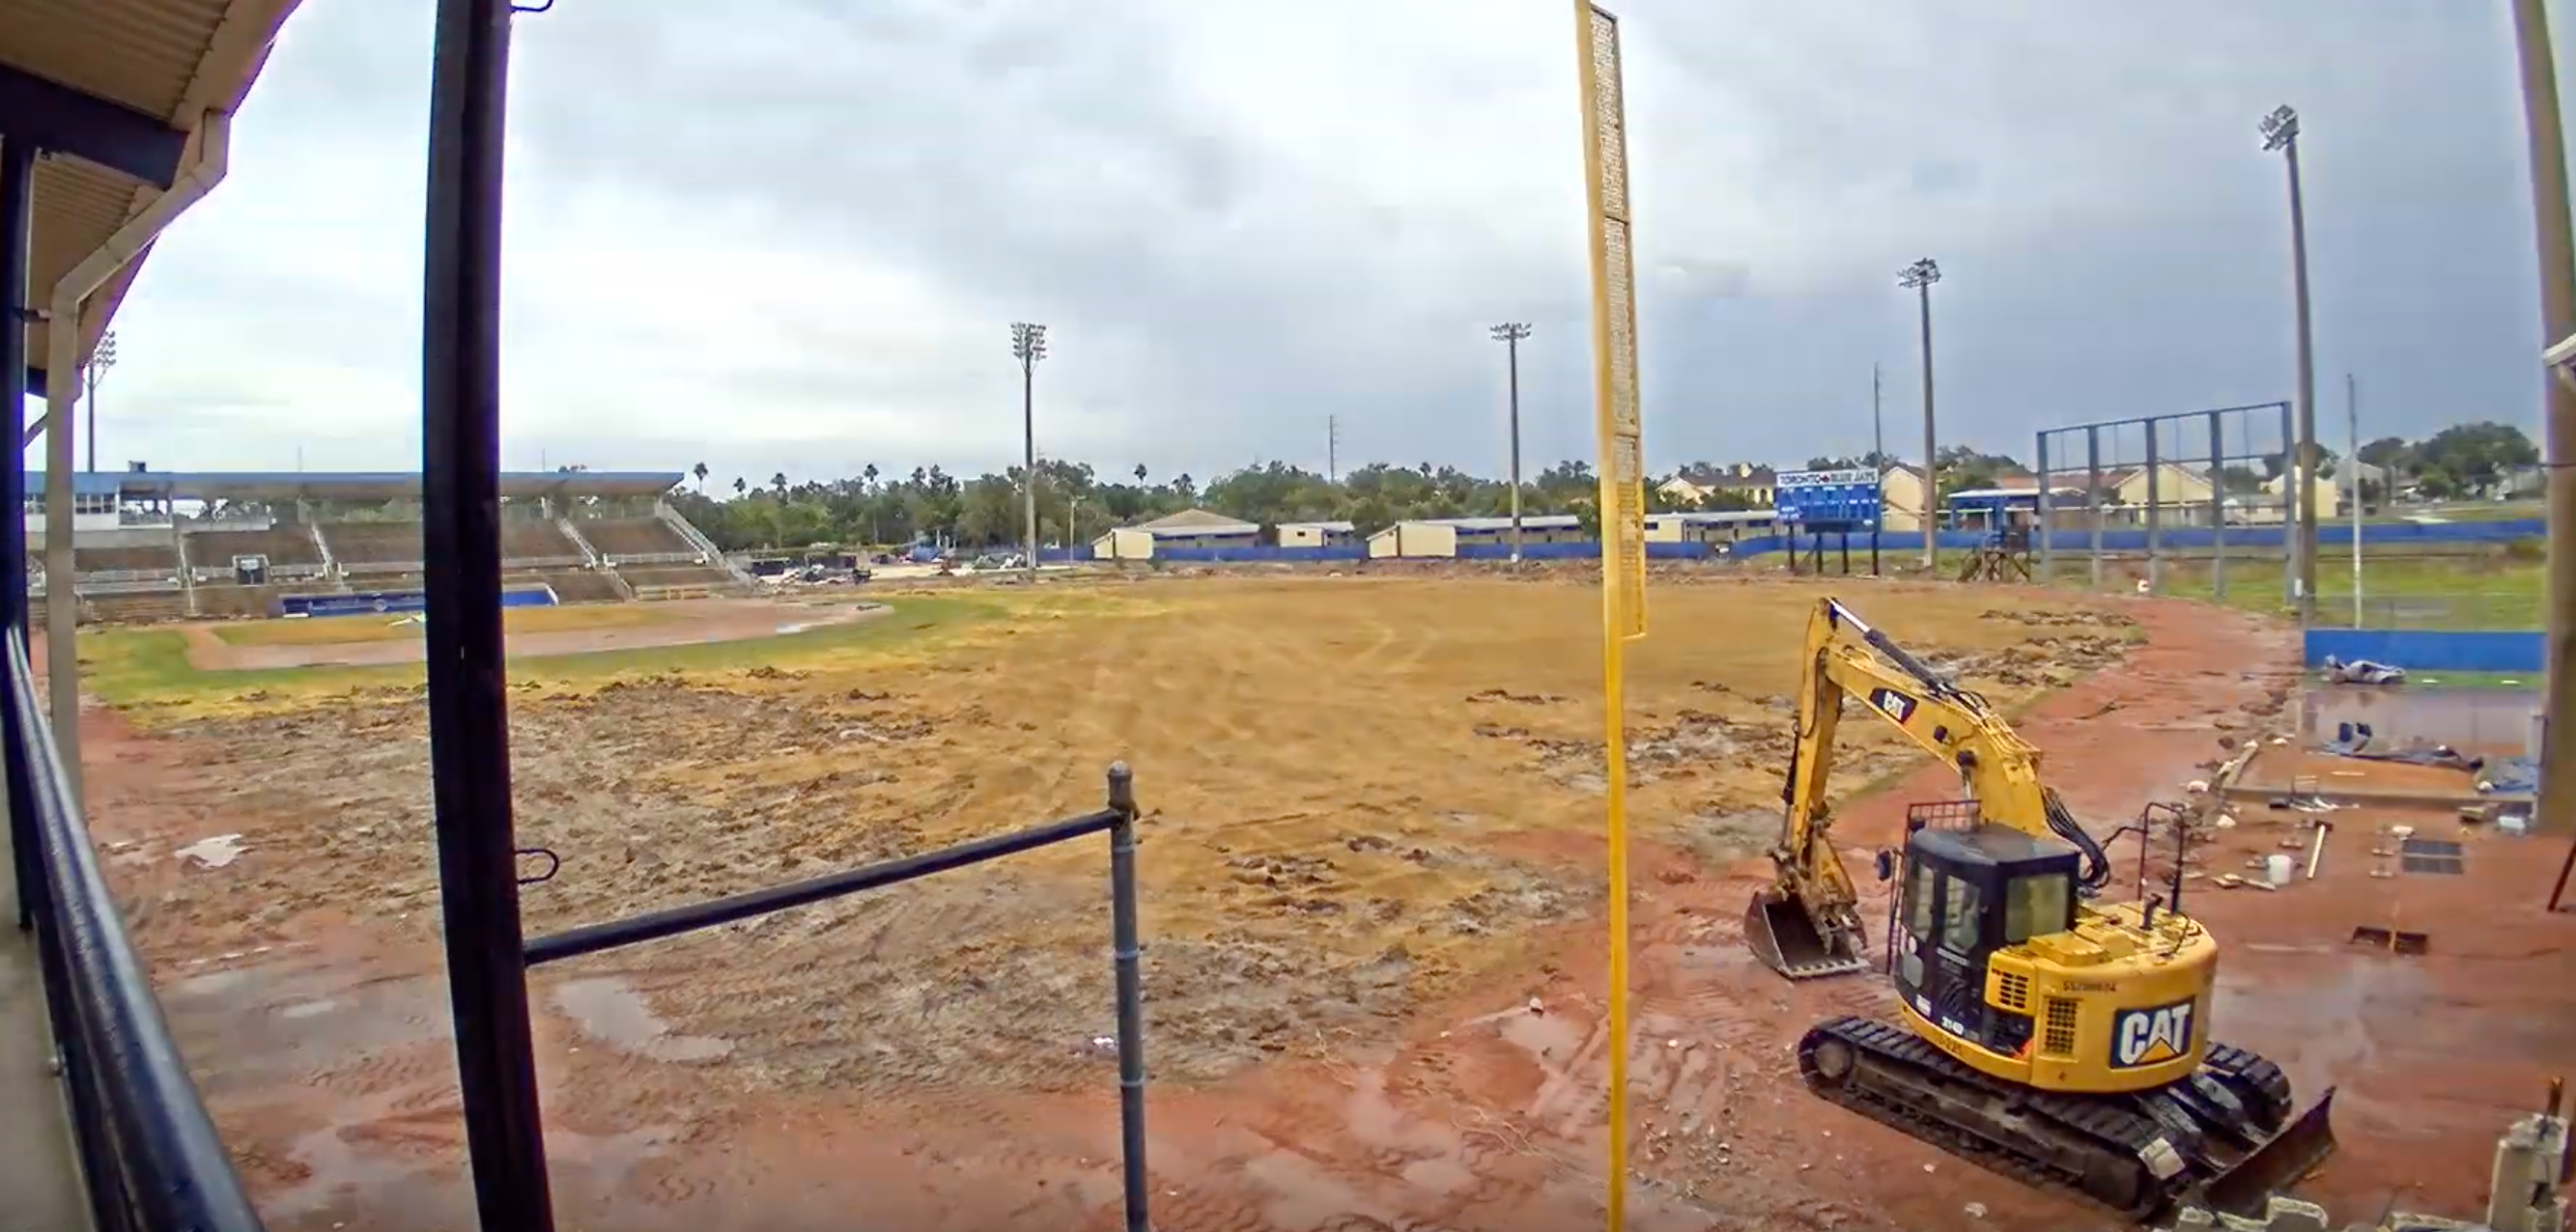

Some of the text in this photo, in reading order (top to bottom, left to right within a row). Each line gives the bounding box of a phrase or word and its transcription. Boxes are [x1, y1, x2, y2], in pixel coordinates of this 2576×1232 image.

[1779, 471, 1877, 485] TORONTO BLUE JAYS
[1882, 690, 1906, 720] CAT
[2119, 1004, 2191, 1064] CAT
